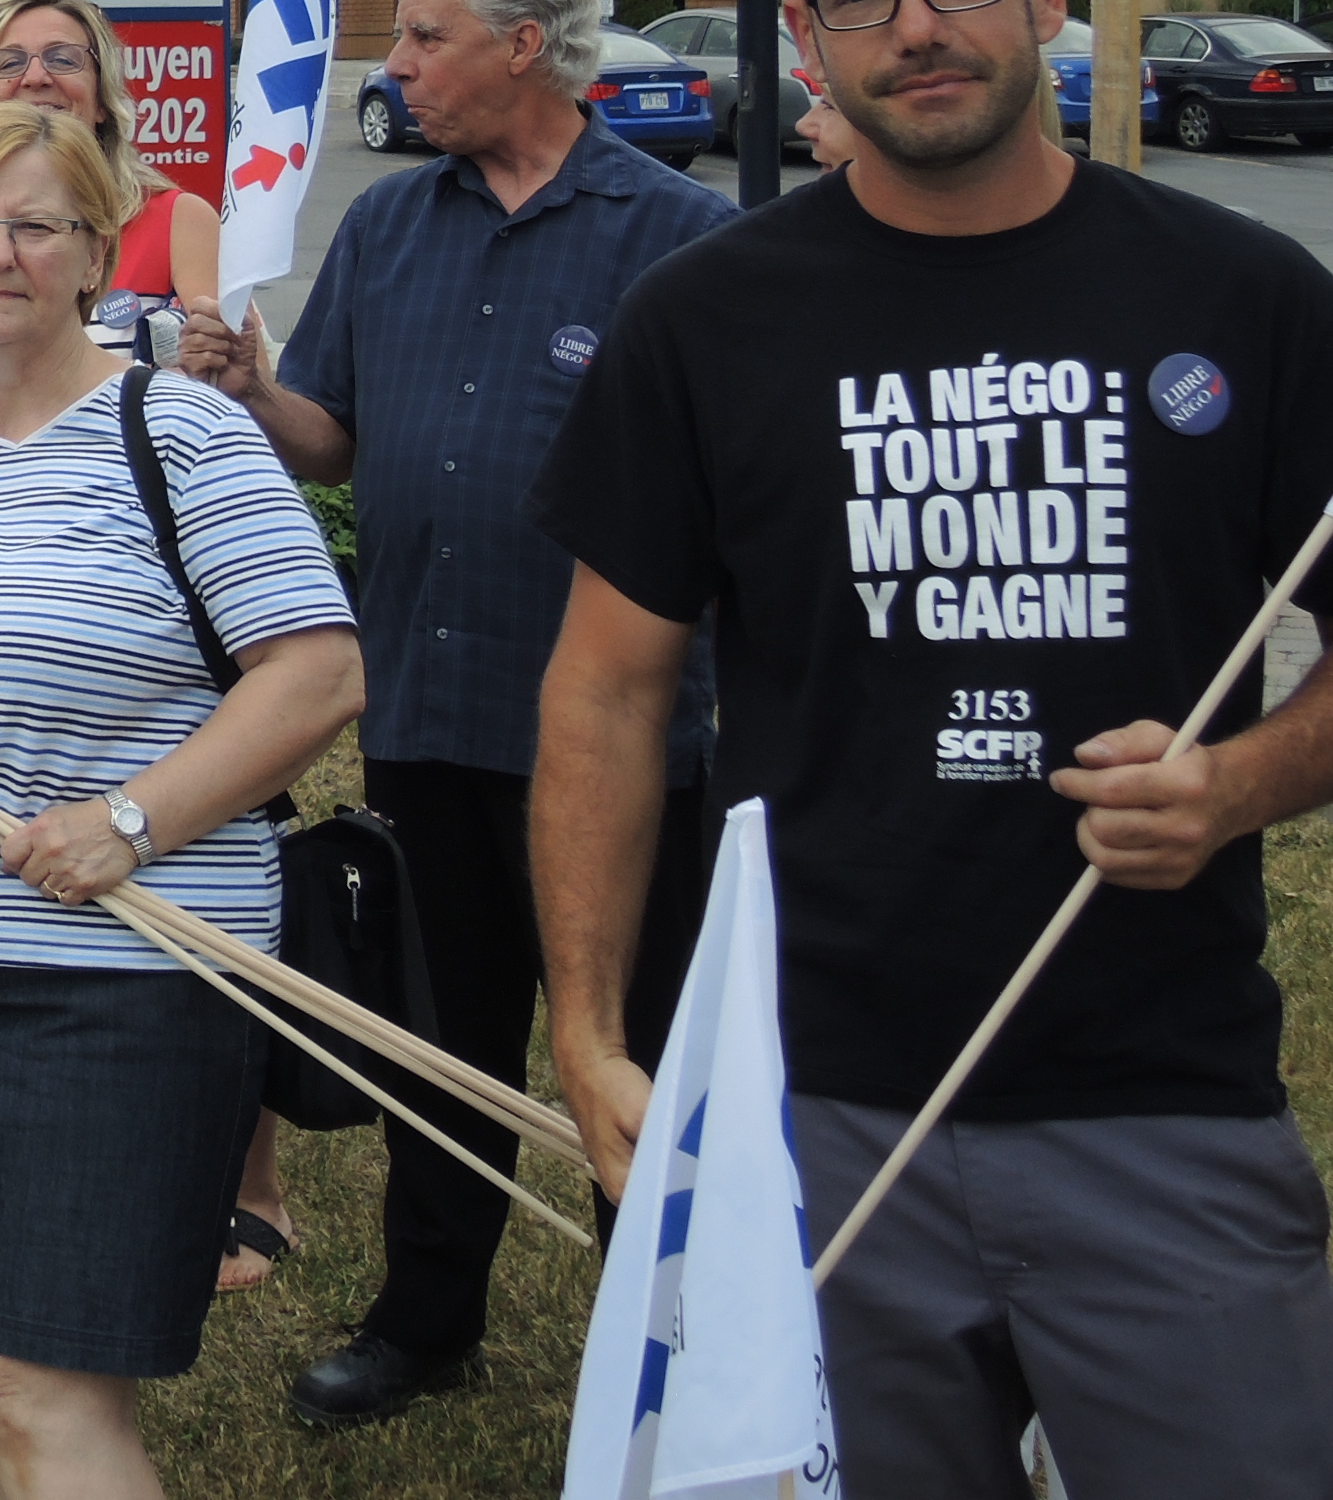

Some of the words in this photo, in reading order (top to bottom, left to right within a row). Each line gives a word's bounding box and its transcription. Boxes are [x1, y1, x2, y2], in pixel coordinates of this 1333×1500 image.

[125, 45, 212, 92] uyen
[103, 295, 133, 313] LIBRE
[104, 307, 130, 322] NÉGO
[552, 347, 583, 364] NÉGO
[559, 337, 594, 356] LIBRE
[839, 373, 916, 429] LA
[930, 353, 1091, 423] NÉGO
[1161, 365, 1211, 408] LIBRE
[1169, 389, 1213, 426] NÉGO
[841, 423, 1018, 495] TOUT
[1040, 420, 1127, 485] LE
[846, 490, 1128, 573] MONDE
[854, 581, 899, 639] Y
[916, 574, 1127, 641] GAGNE
[948, 689, 1031, 722] 3153
[936, 728, 1043, 760] SCFP
